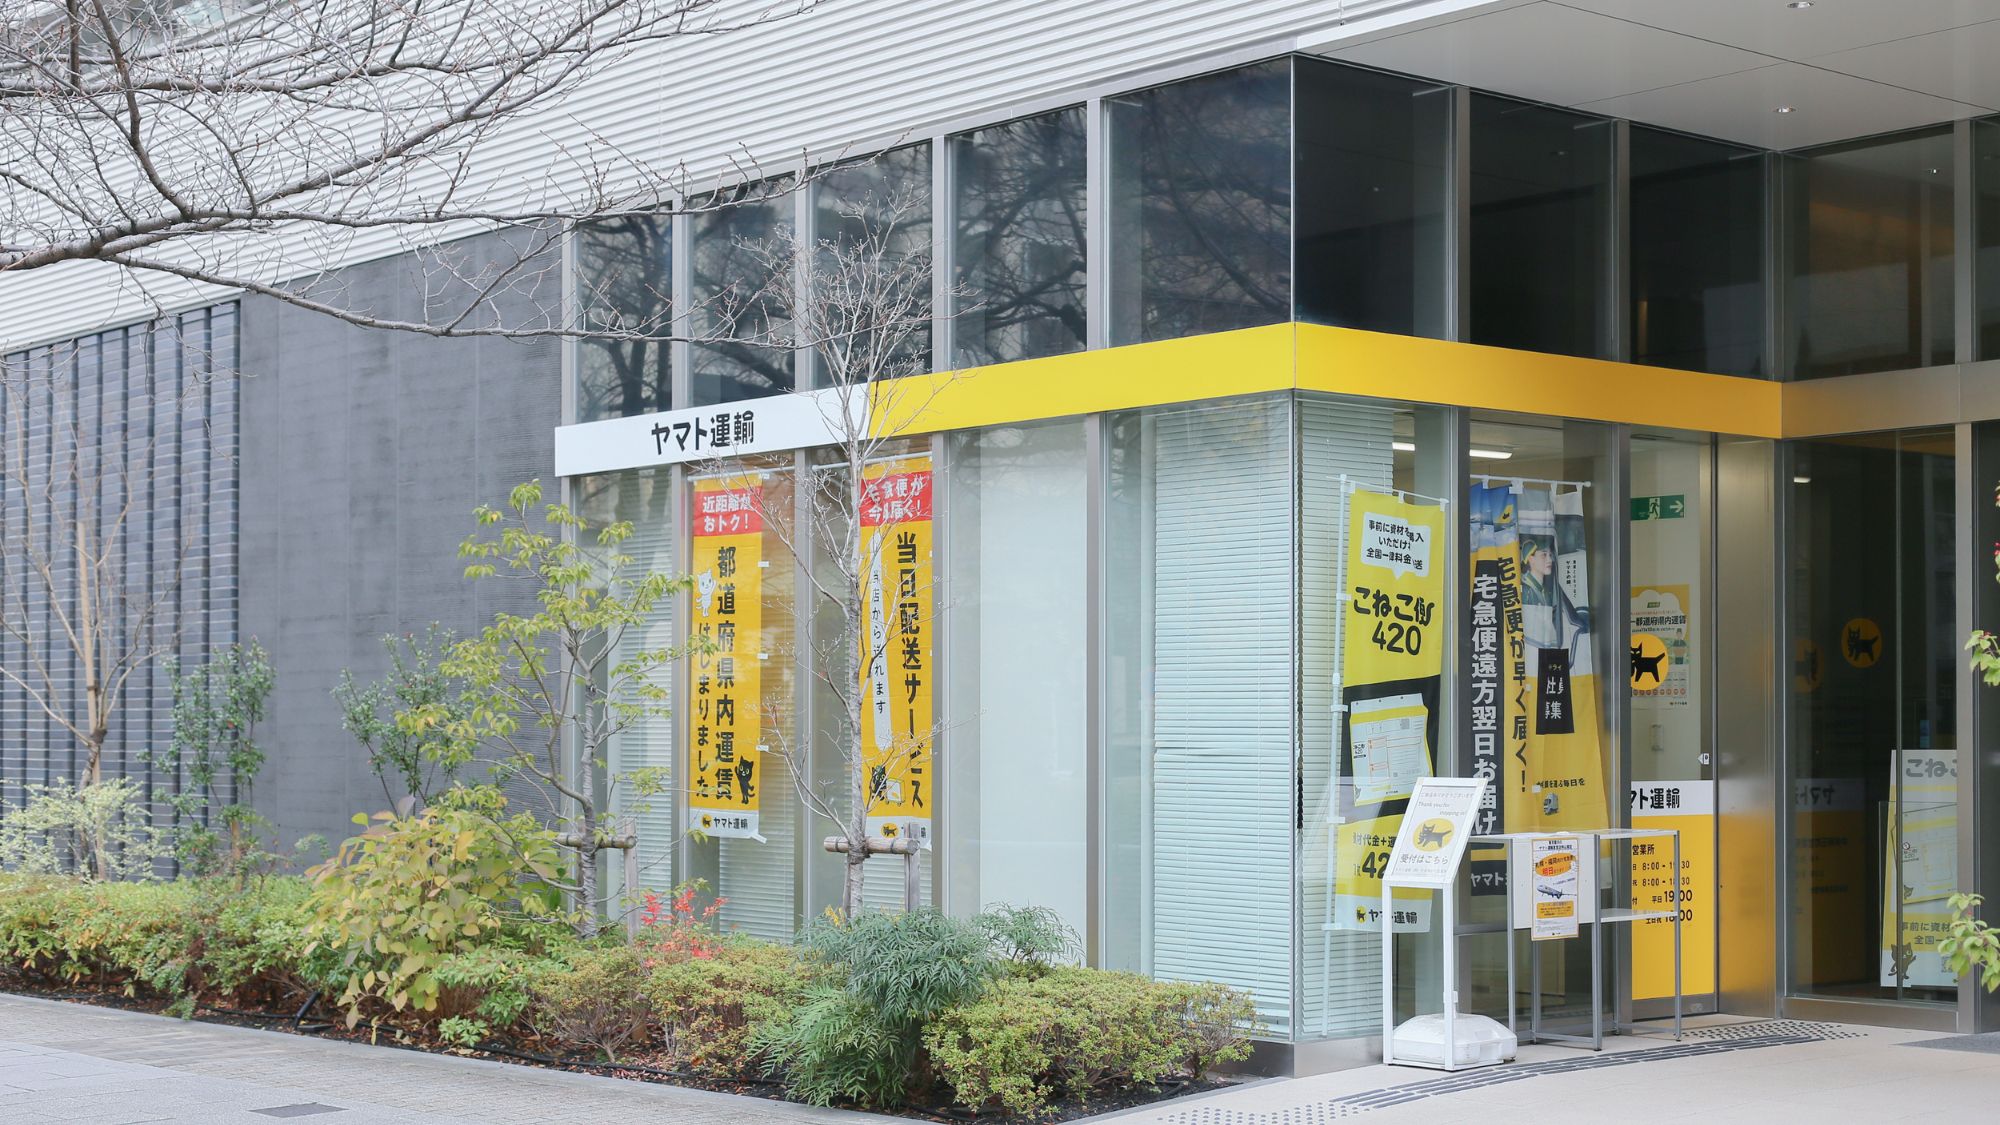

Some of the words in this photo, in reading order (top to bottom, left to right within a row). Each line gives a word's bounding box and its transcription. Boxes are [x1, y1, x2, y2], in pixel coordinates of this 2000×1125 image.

[651, 410, 754, 455] ヤマト運輸
[1372, 620, 1422, 657] 420
[715, 546, 736, 801] 都道府県内運賃
[897, 532, 922, 808] 当日配送サービス
[1471, 573, 1498, 836] 宅急便遠方翌日お届け
[713, 816, 748, 830] ヤマト運輸
[1632, 844, 1655, 855] 営業所
[1400, 854, 1448, 865] 受付はこちら
[1642, 862, 1660, 871] 8:00
[1471, 872, 1508, 888] ヤマト
[1642, 878, 1660, 887] 8:00
[1652, 896, 1662, 904] 平日
[1664, 889, 1693, 903] 1900
[1369, 908, 1418, 925] ヤ運輸
